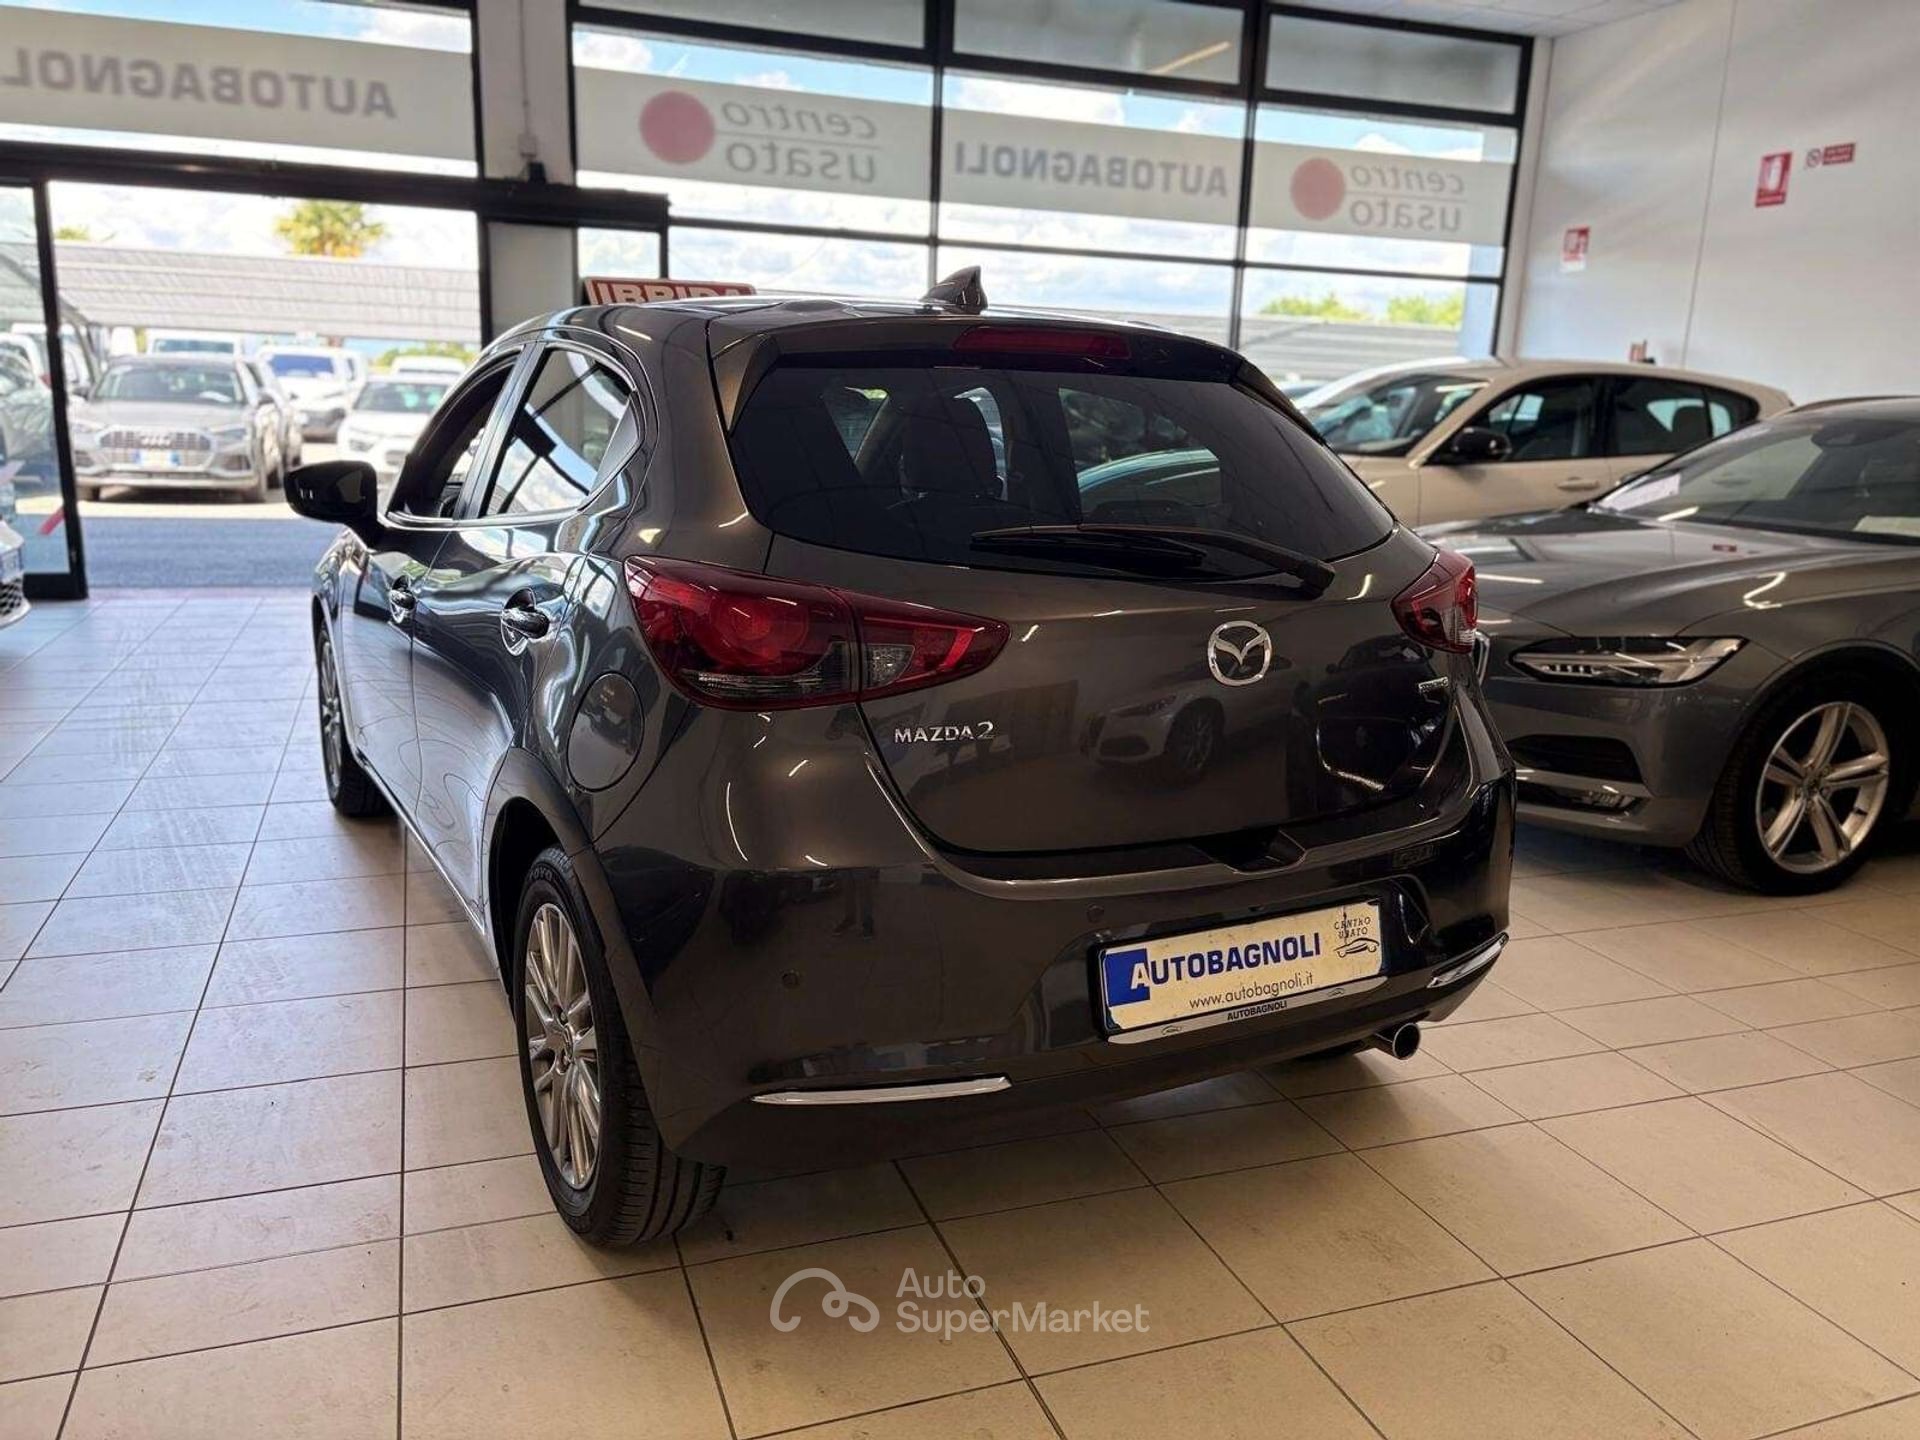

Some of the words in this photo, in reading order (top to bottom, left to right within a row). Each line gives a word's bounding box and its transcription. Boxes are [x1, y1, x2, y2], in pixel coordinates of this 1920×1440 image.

[1130, 932, 1321, 990] AUTOBAGNOLI
[1189, 971, 1314, 1009] www.autobagnoli.it
[1227, 1000, 1288, 1021] AUTOBAGNOLI
